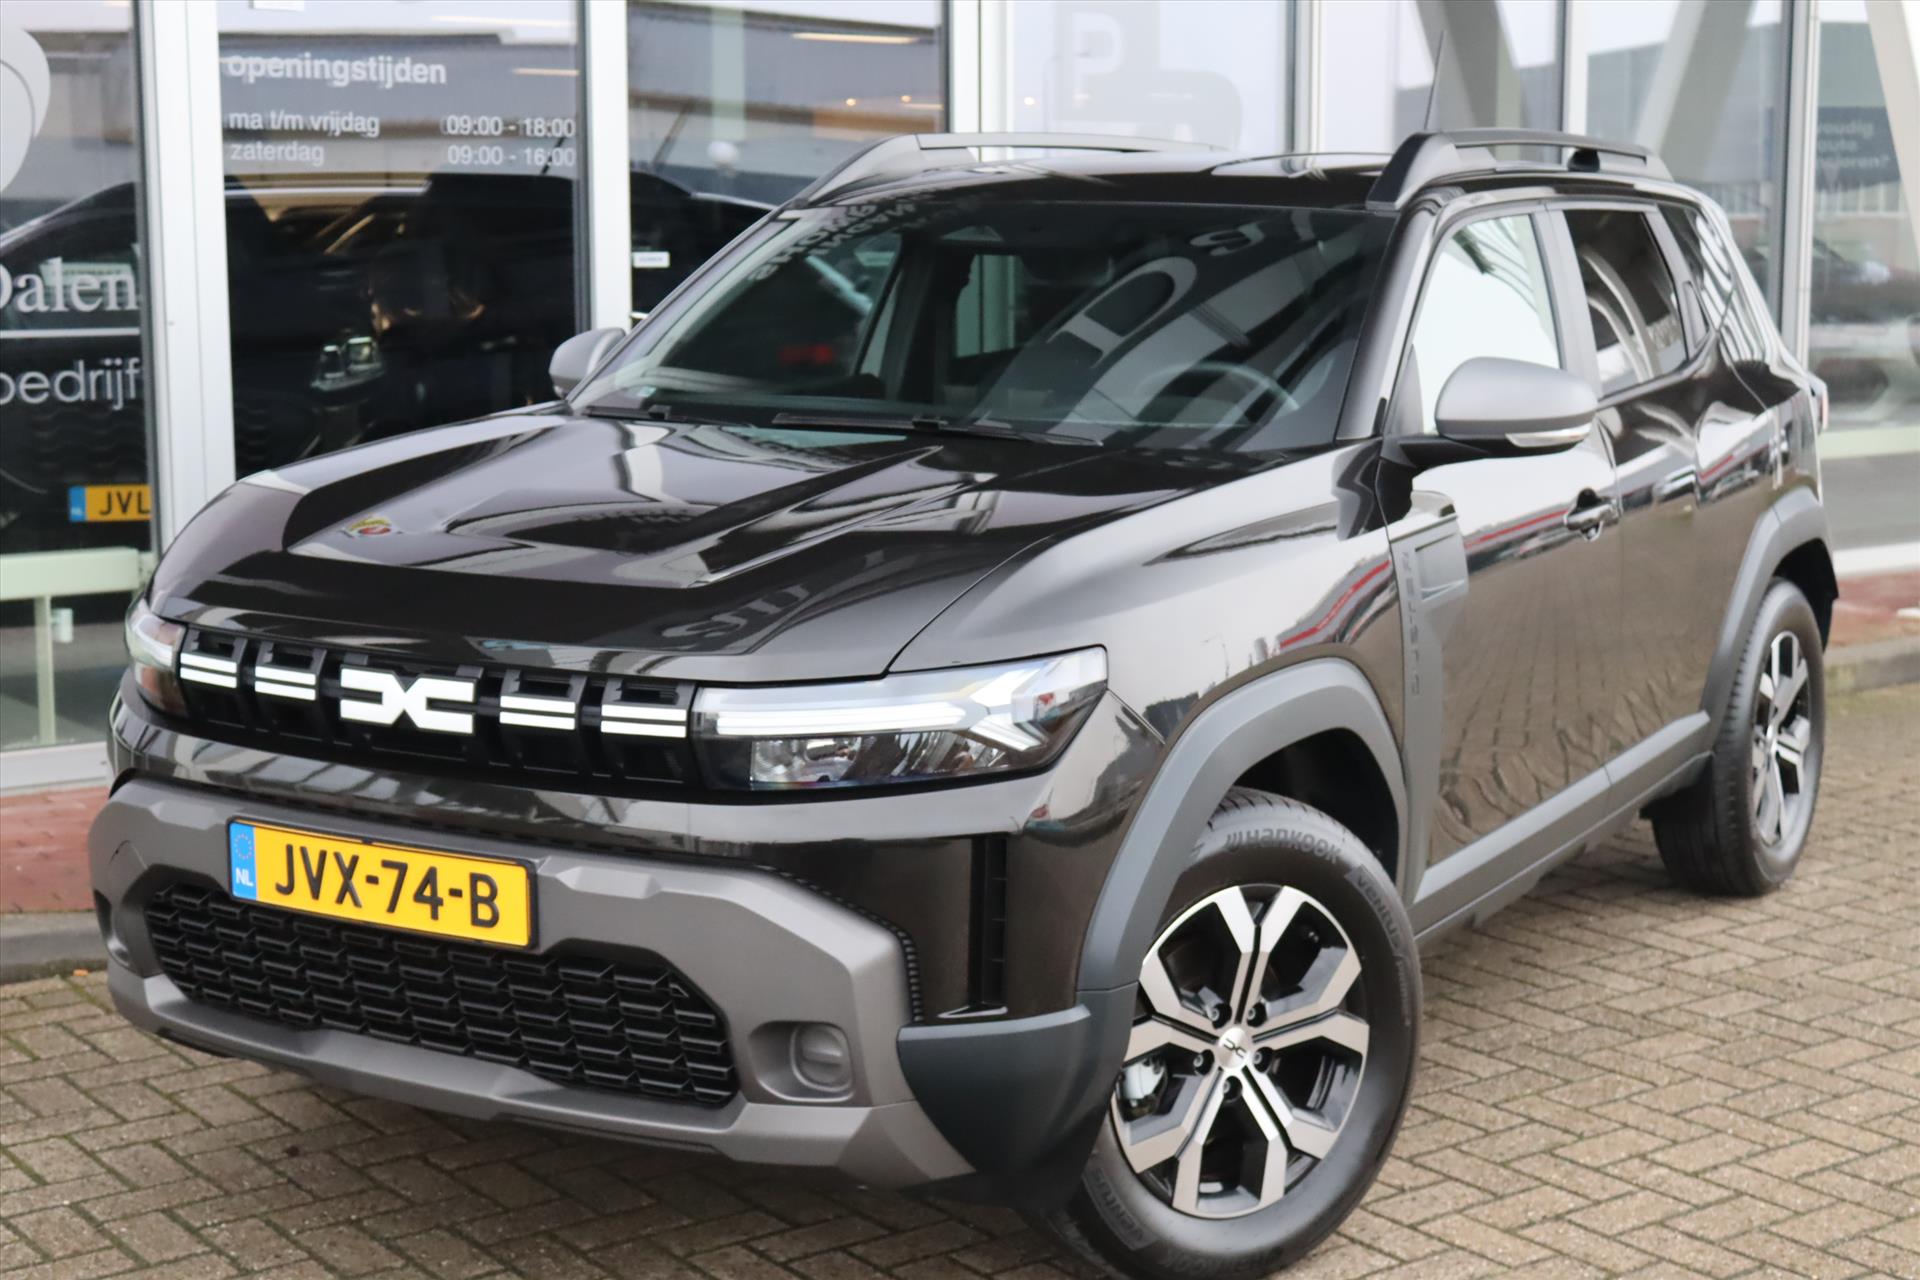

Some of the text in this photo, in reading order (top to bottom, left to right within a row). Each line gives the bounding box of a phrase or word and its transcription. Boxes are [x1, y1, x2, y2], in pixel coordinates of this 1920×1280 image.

[228, 52, 447, 88] openingstijden
[228, 113, 264, 131] ma
[270, 112, 305, 132] t/m
[310, 112, 381, 139] vrijdag
[446, 115, 502, 137] 09:00
[524, 118, 577, 139] 18:00
[230, 141, 325, 167] zaterdag
[446, 145, 502, 167] 09:00
[524, 148, 577, 168] 16:00
[235, 844, 500, 929] NL JVX-74-B
